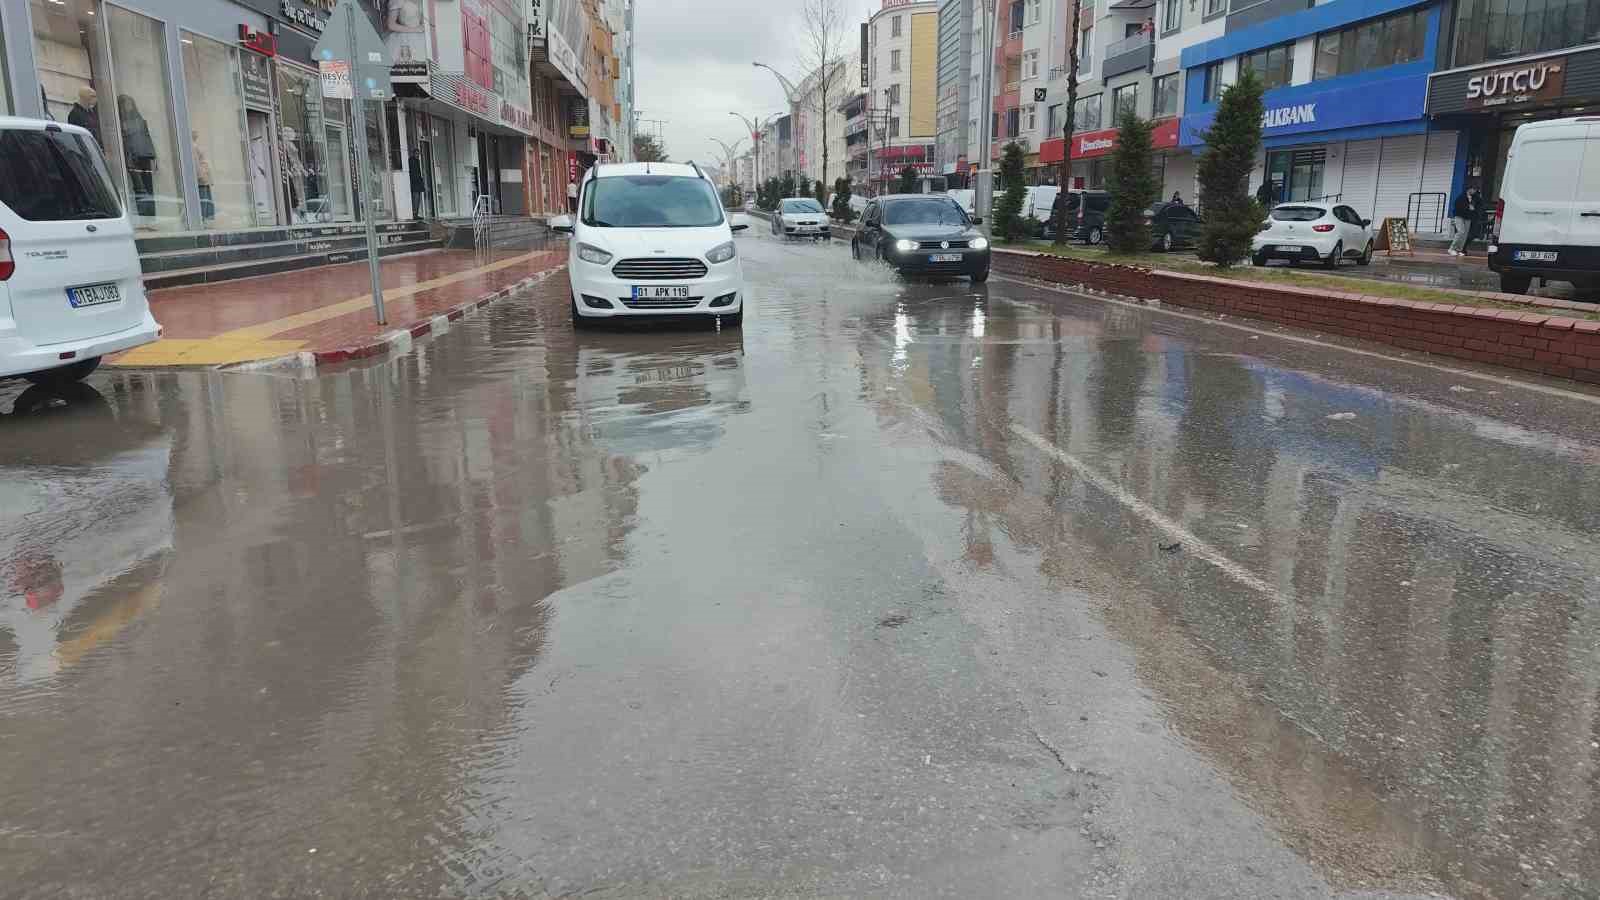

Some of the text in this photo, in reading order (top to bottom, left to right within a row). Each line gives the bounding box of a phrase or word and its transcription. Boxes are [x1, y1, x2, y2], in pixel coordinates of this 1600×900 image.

[1260, 103, 1317, 128] ALKBANK
[638, 287, 687, 297] 01 APK 119
